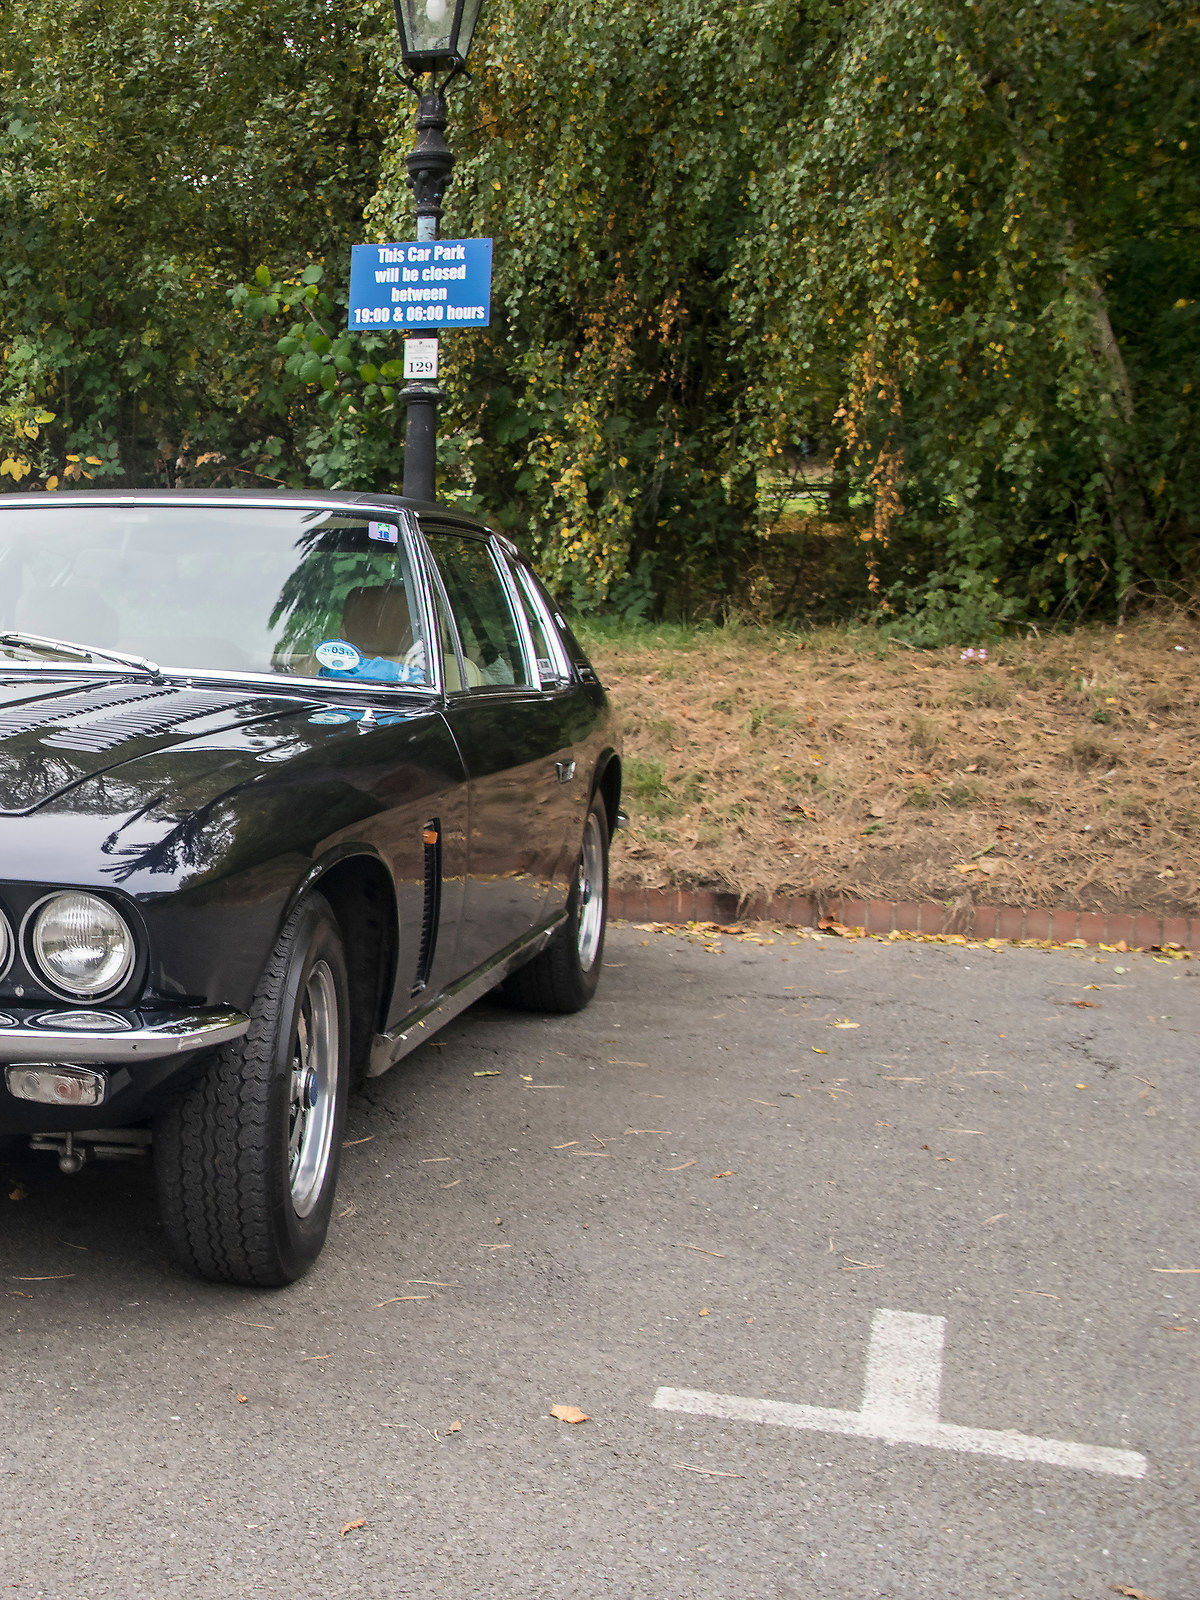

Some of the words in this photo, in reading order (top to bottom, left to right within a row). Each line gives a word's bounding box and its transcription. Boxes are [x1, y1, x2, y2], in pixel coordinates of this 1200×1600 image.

[378, 247, 405, 264] This
[407, 246, 431, 262] Car
[434, 244, 466, 261] Park
[375, 267, 399, 283] will
[402, 266, 419, 282] be
[422, 264, 467, 282] closed
[391, 287, 447, 303] between
[354, 307, 390, 324] 19:00
[392, 306, 404, 322] &
[406, 305, 444, 321] 06:00
[447, 304, 485, 320] hours
[409, 361, 433, 373] 129
